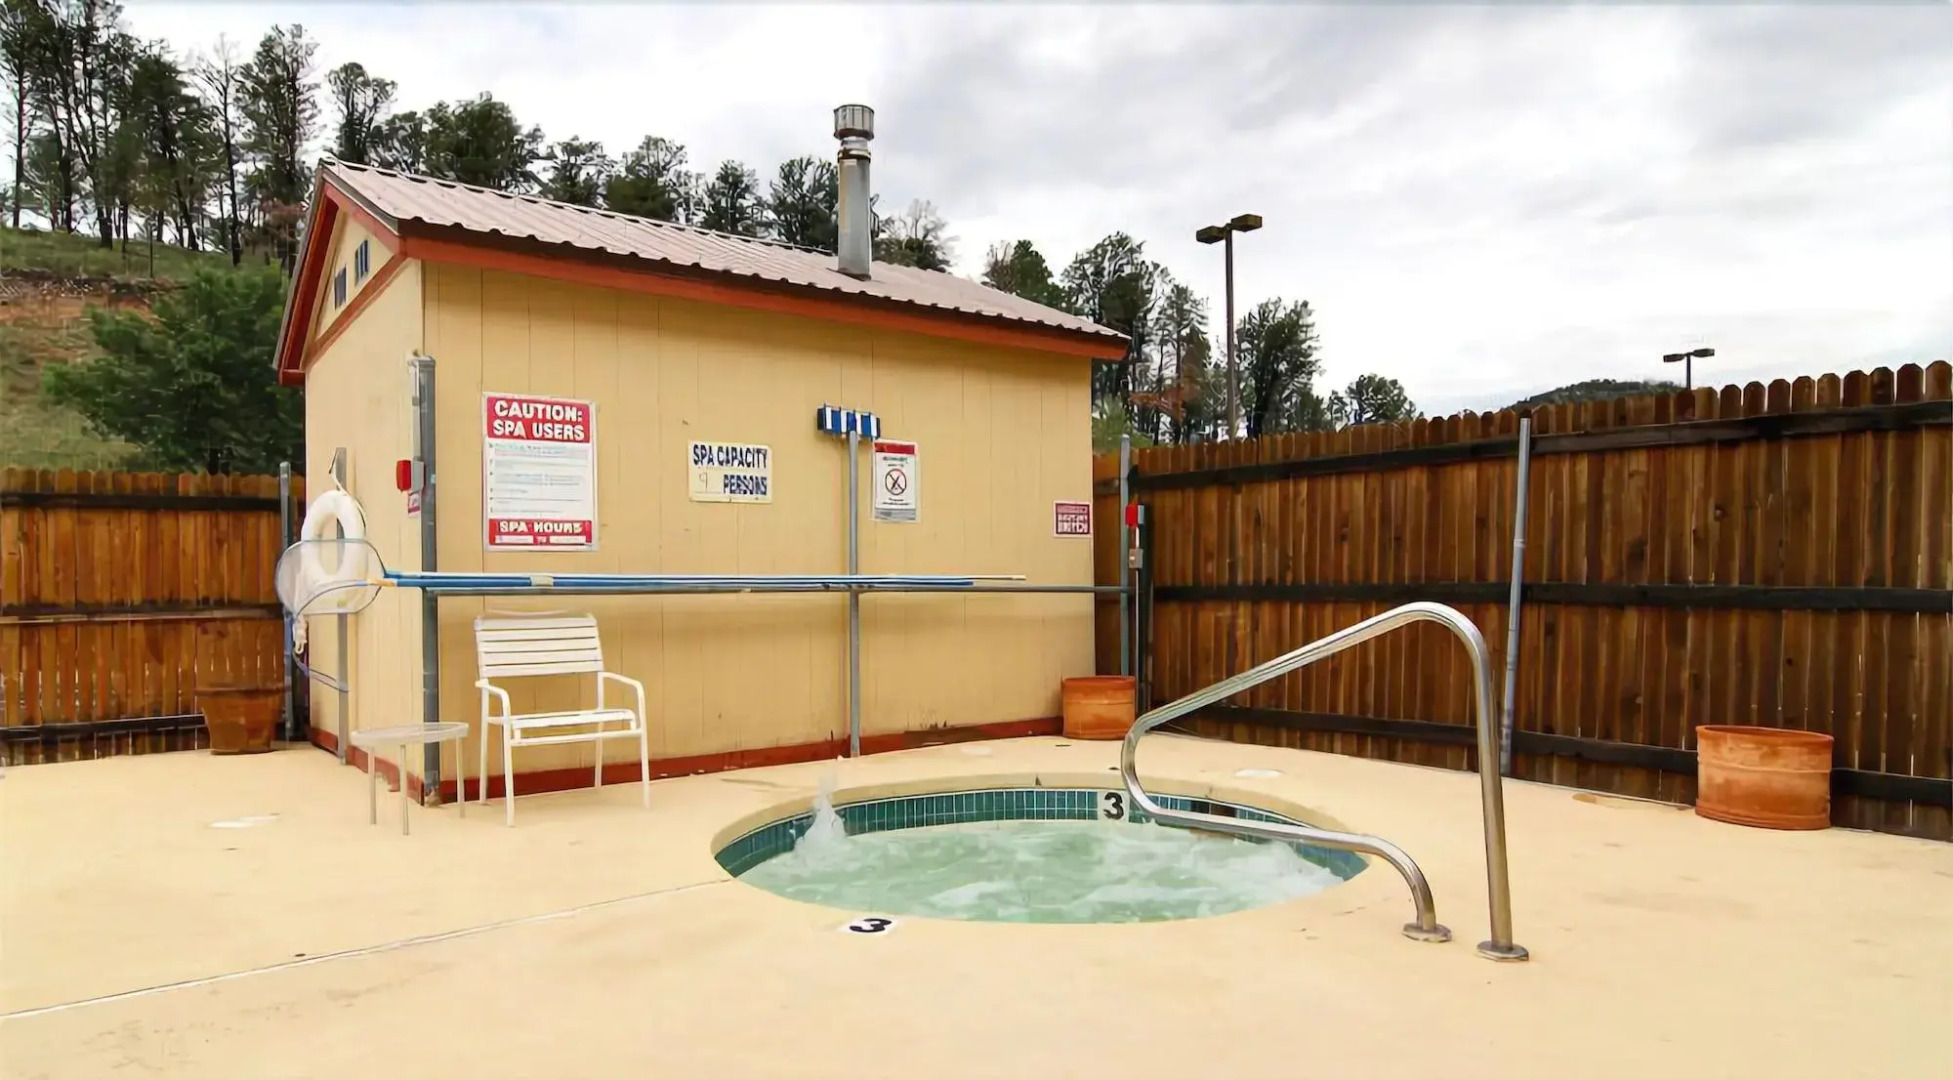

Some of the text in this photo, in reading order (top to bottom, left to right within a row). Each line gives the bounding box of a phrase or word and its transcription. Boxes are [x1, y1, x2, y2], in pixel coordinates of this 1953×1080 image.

[494, 400, 583, 422] CAUTION:
[492, 419, 585, 441] SPA USERS
[693, 444, 768, 469] SPA CAPACITY
[723, 474, 768, 496] PERSONS
[499, 520, 583, 534] SPA HOURS
[1103, 791, 1125, 820] 3
[849, 918, 892, 933] 3
